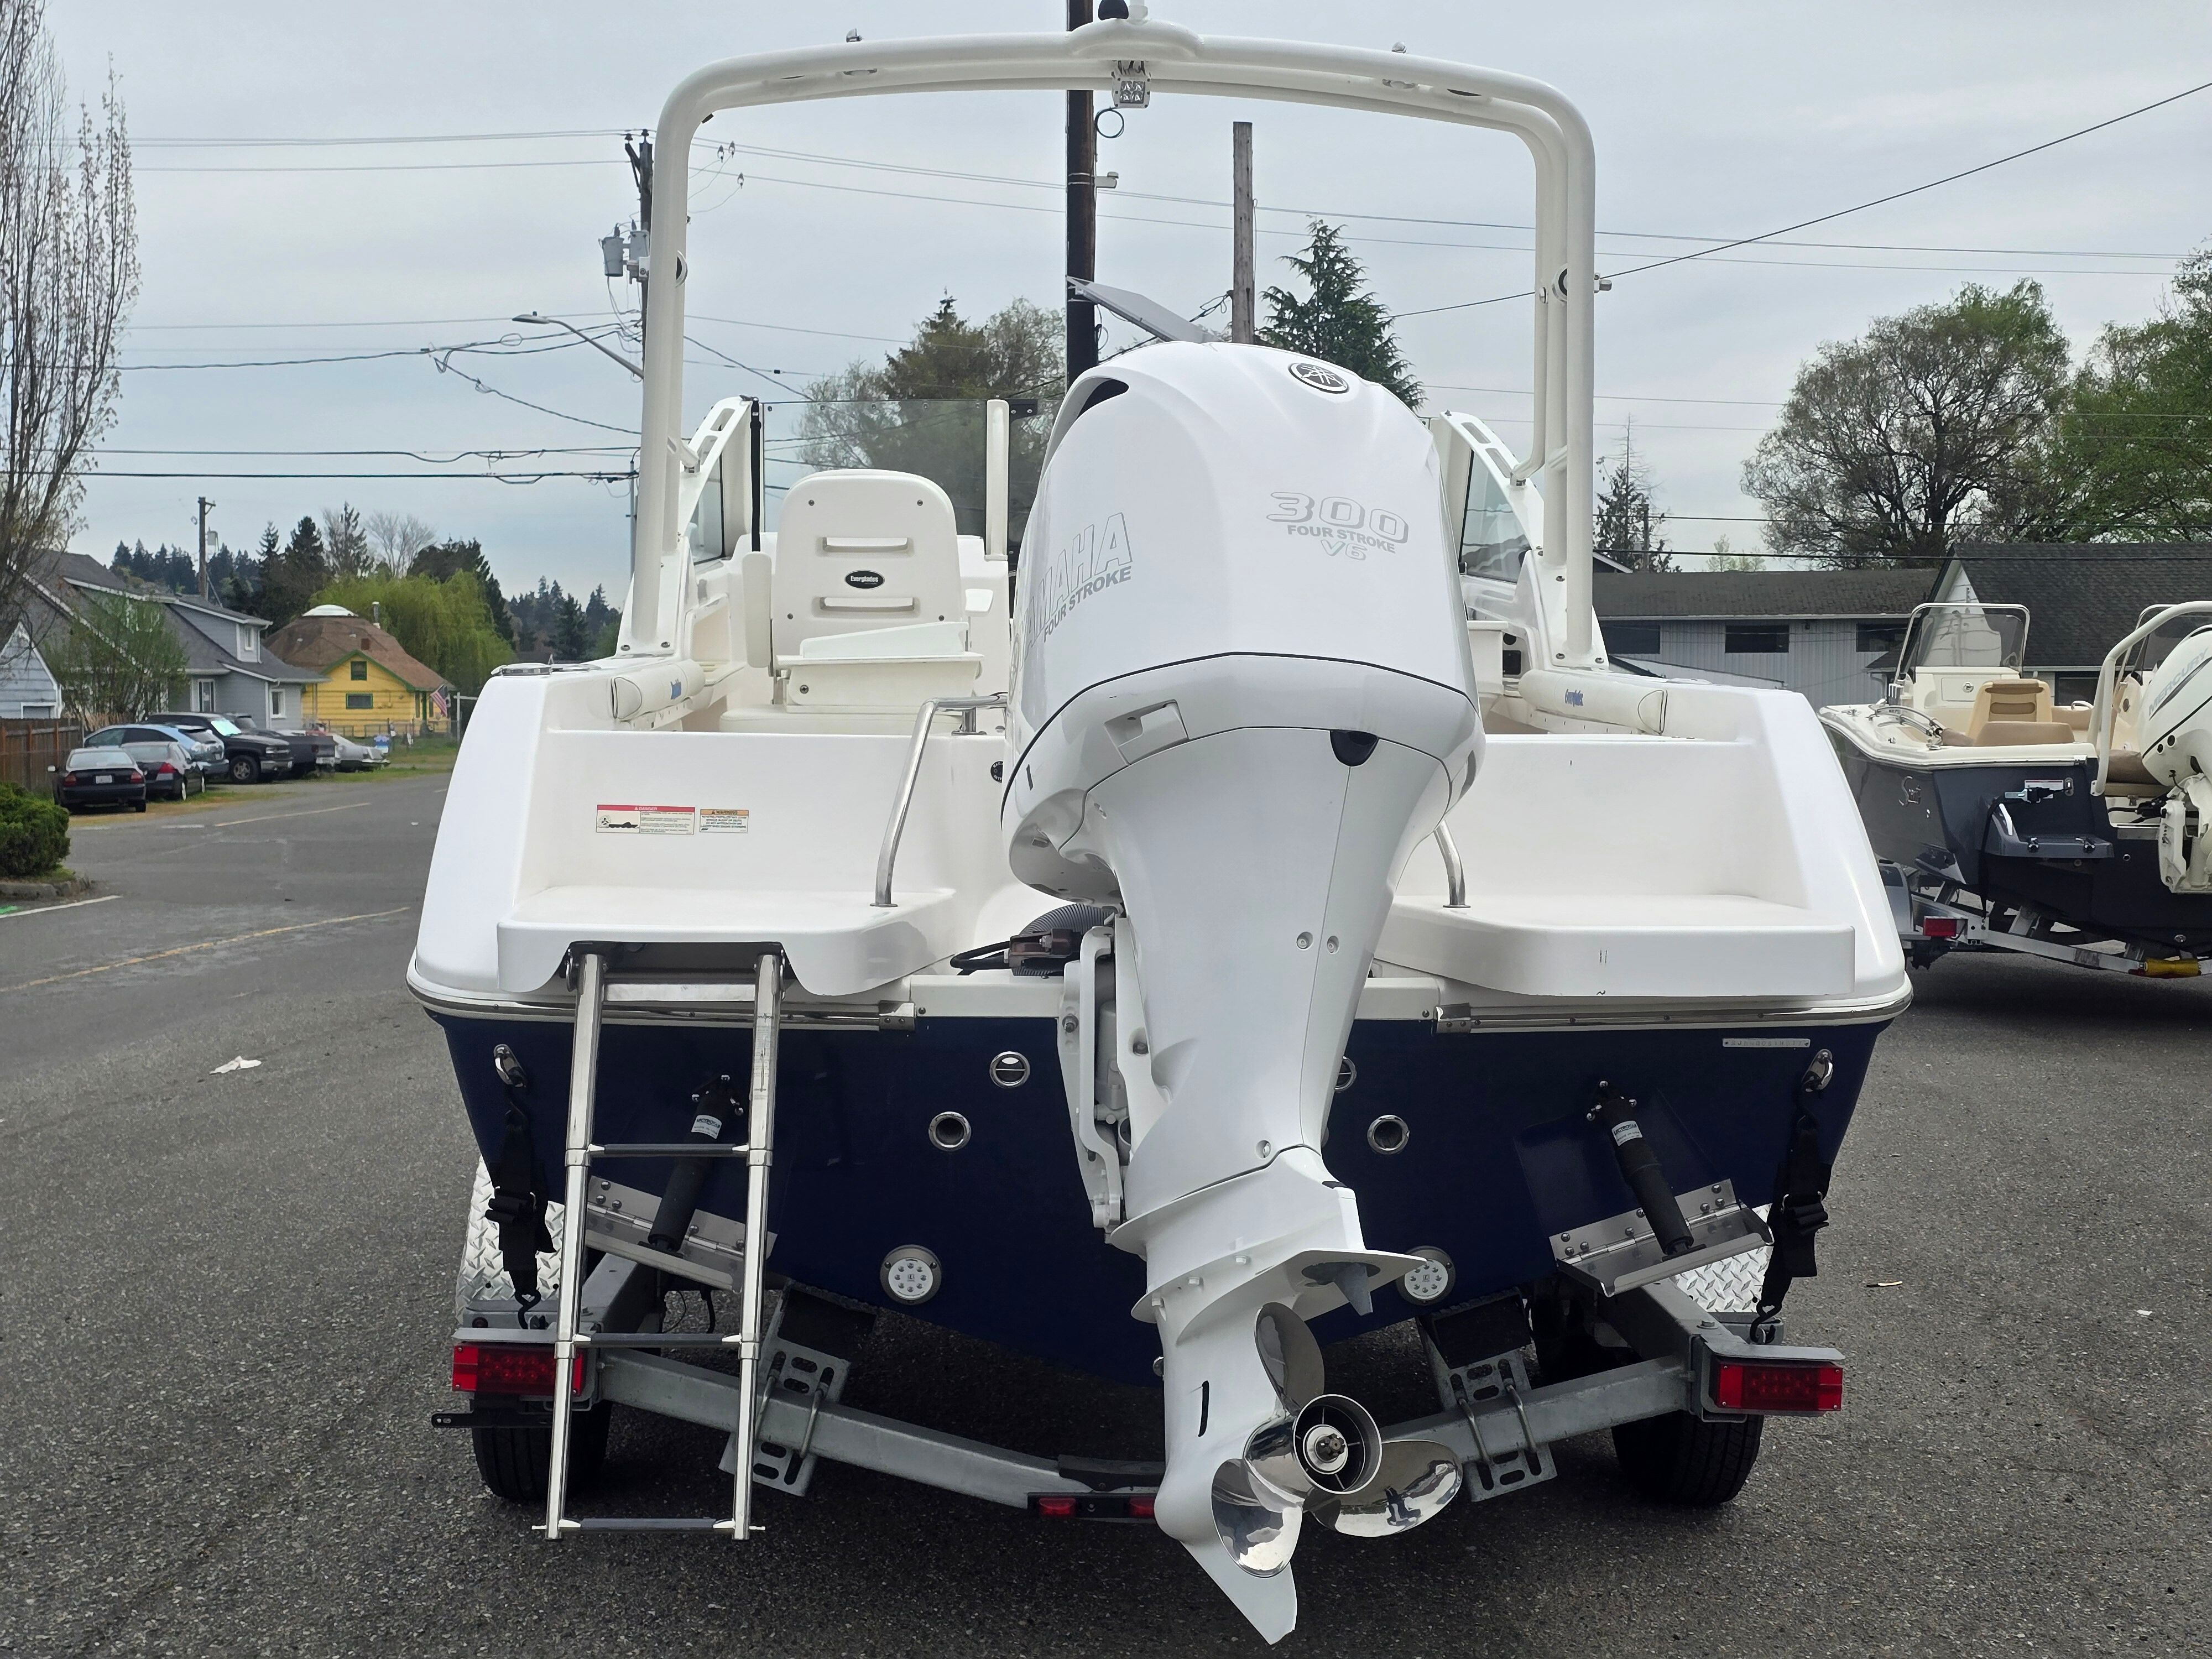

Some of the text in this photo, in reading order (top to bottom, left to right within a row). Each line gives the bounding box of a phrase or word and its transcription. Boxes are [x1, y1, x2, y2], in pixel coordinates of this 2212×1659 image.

[1266, 491, 1408, 544] 300
[1287, 525, 1396, 554] FOUR STROKE
[1320, 539, 1368, 561] V6
[1044, 566, 1132, 643] FOUR STROKE
[2148, 647, 2208, 717] MERCURY
